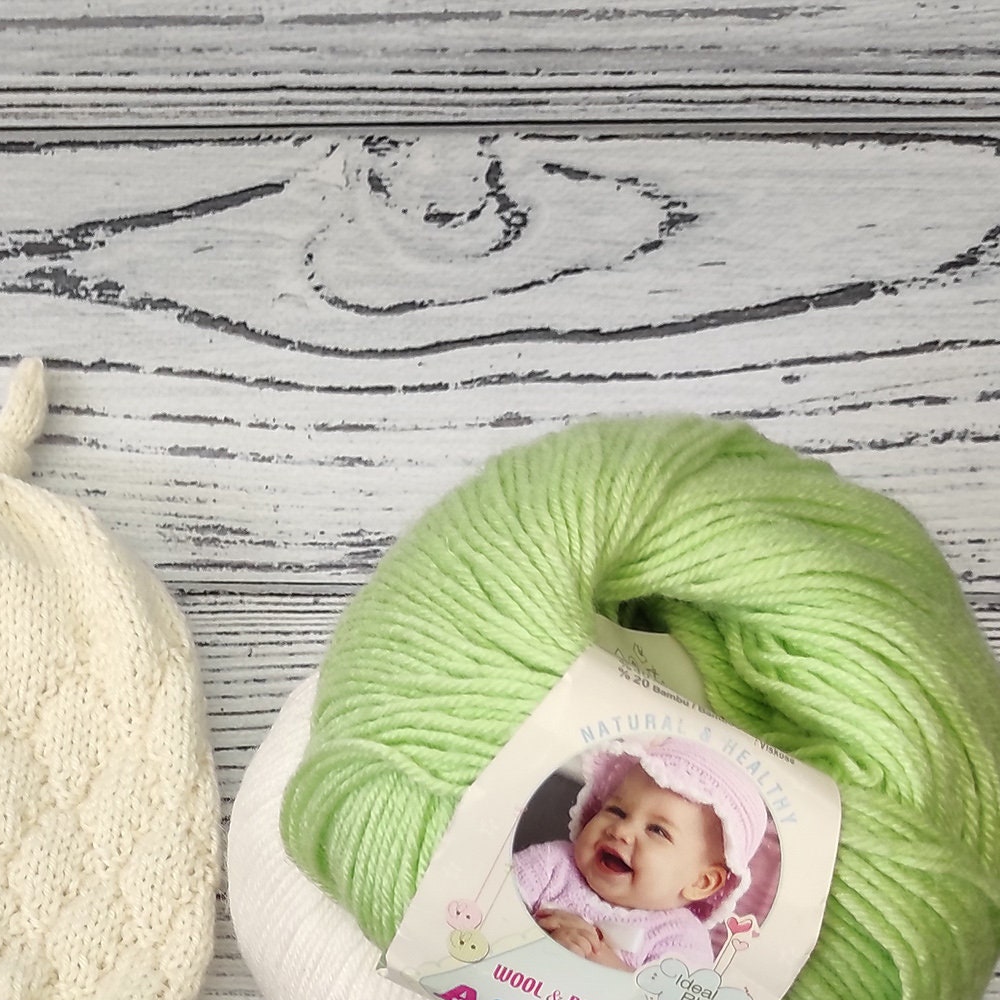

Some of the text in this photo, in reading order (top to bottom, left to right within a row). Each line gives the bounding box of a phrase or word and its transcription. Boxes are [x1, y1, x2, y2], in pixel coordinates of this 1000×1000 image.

[618, 666, 631, 681] %
[633, 676, 650, 688] 20
[652, 684, 690, 707] Bambu
[580, 713, 798, 826] NATURAL & HEALTHY
[493, 963, 543, 999] WOOL
[675, 974, 718, 1000] Ideal
